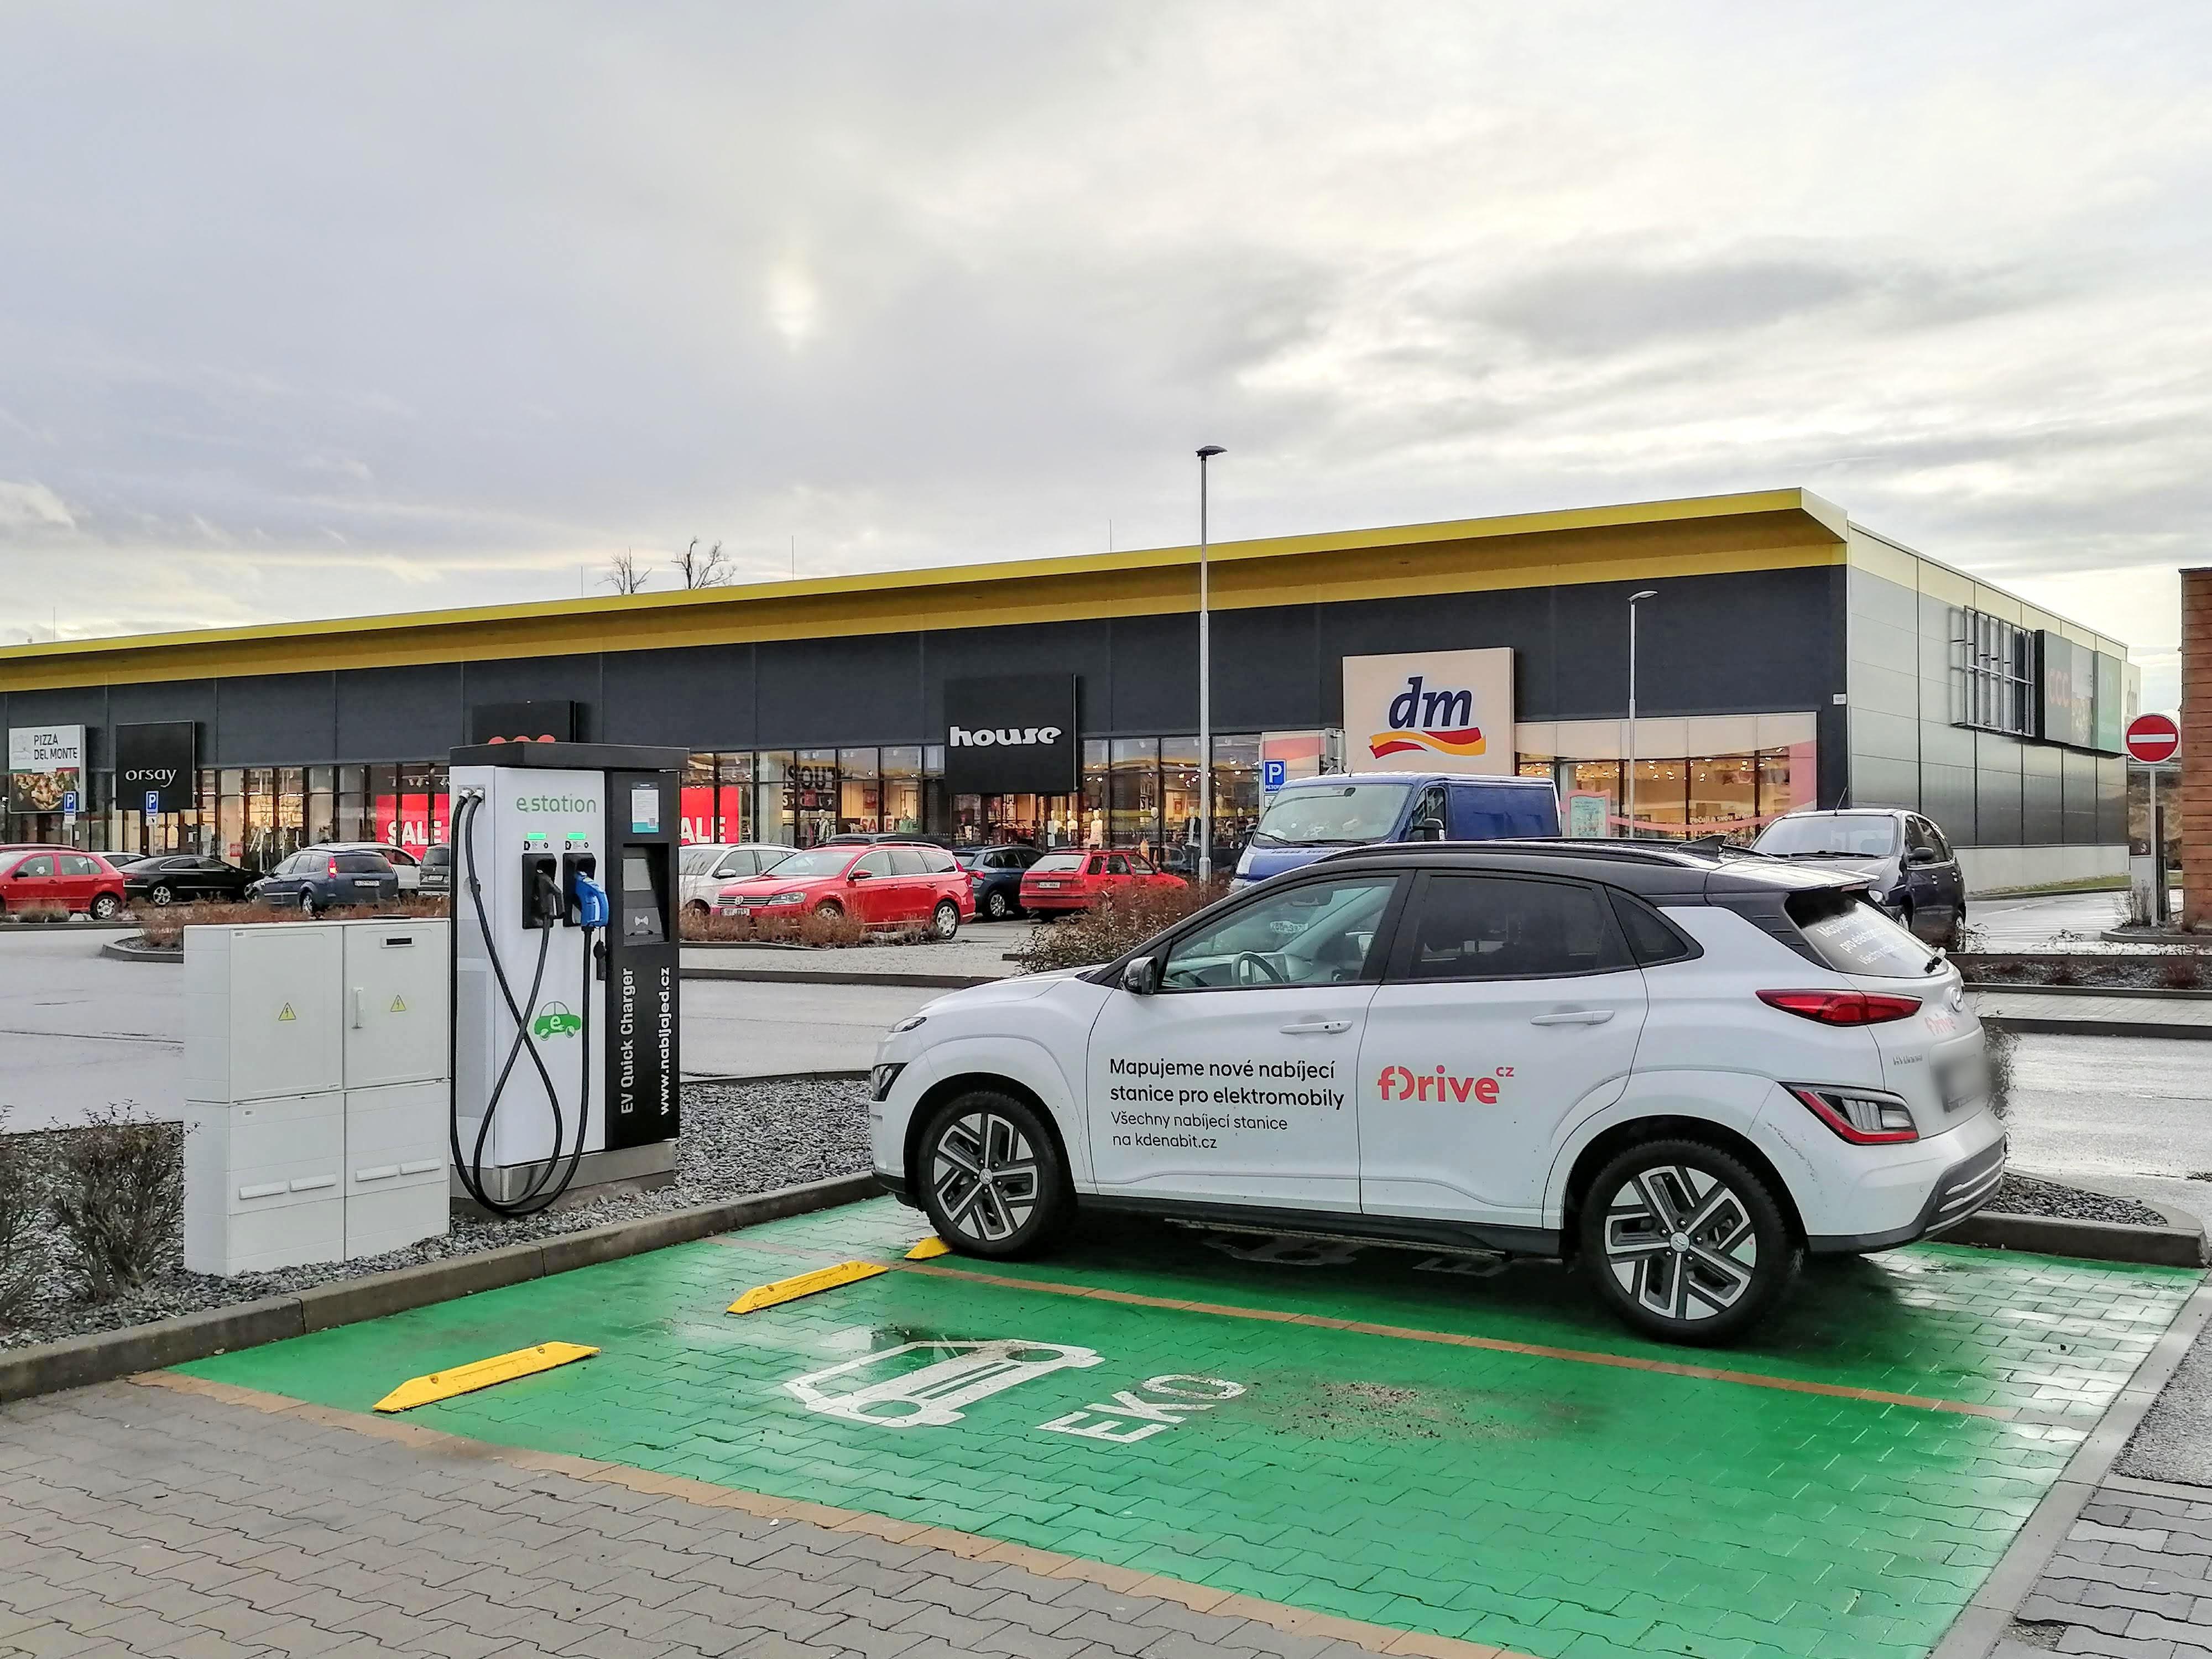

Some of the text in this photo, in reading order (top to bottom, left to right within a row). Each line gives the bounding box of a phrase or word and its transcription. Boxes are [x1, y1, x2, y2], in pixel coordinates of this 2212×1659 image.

[1389, 676, 1472, 729] dm
[34, 733, 59, 746] PIZZA
[950, 726, 1062, 747] house
[34, 747, 77, 760] DEL MONTE
[125, 768, 177, 787] orsay
[1269, 764, 1282, 783] P
[67, 794, 74, 808] P
[148, 795, 155, 808] P
[861, 818, 893, 832] SAE
[620, 968, 636, 1115] EV Quick Charger
[659, 967, 671, 1115] www.nabijajed.cz
[1109, 1058, 1335, 1082] Mapujeme nové nabíjecí
[1110, 1084, 1345, 1110] stanice pro elektromobily
[1110, 1110, 1288, 1130] Všechny nabíjecí stanice
[1112, 1133, 1218, 1149] na kdenabit.cz
[1035, 1374, 1248, 1444] EKO
